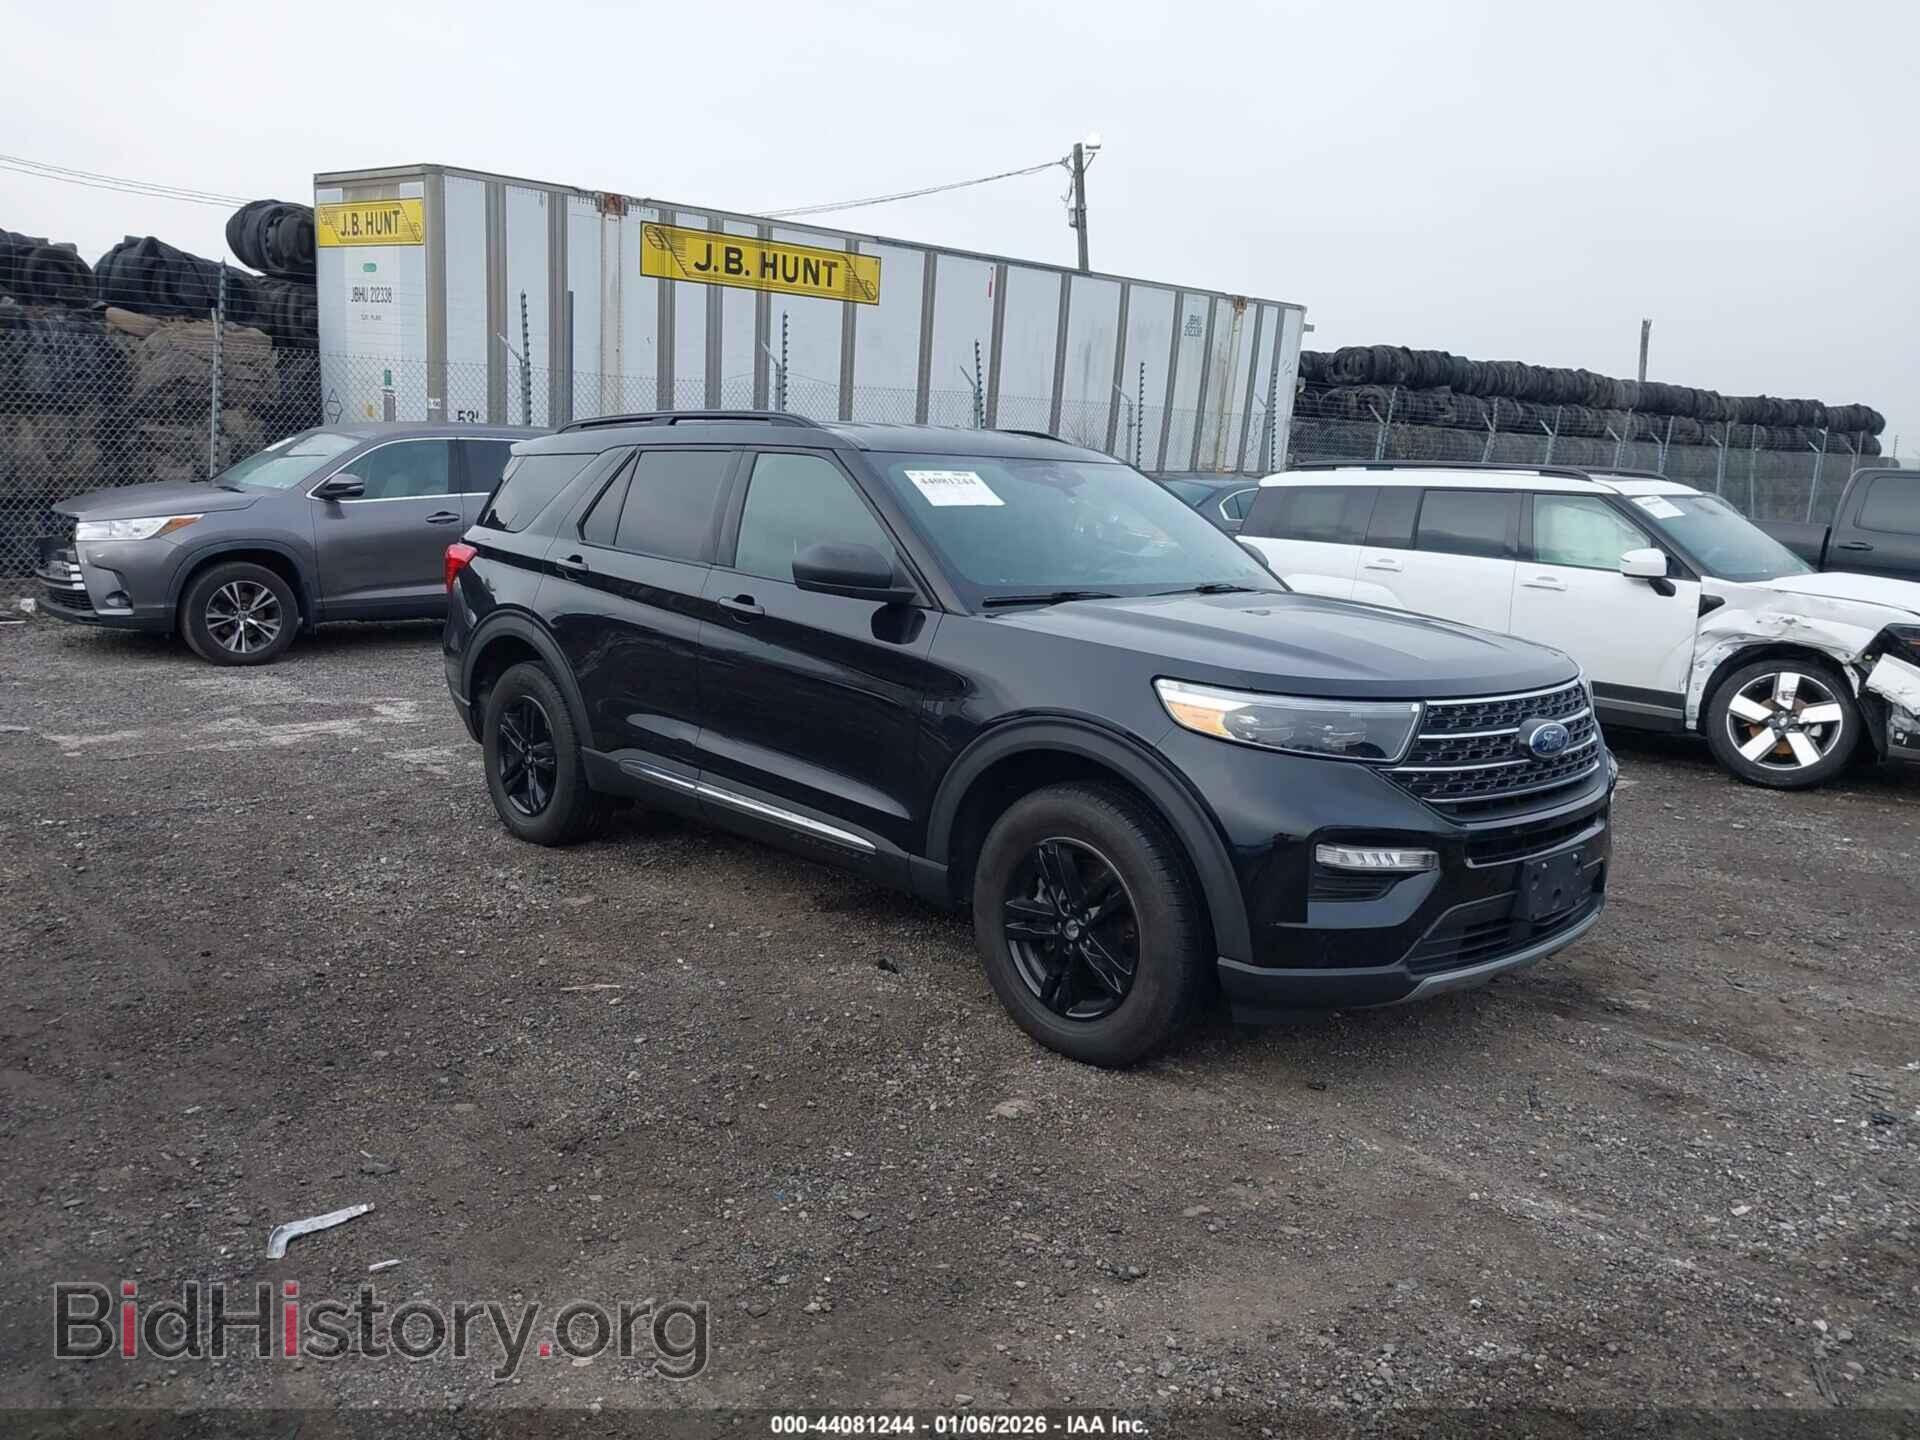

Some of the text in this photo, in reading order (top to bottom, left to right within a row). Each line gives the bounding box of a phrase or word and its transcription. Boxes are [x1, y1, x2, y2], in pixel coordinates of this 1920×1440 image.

[340, 210, 400, 237] J.B. HUNT
[694, 243, 838, 287] J.B. HUNT
[351, 286, 368, 303] JBHU
